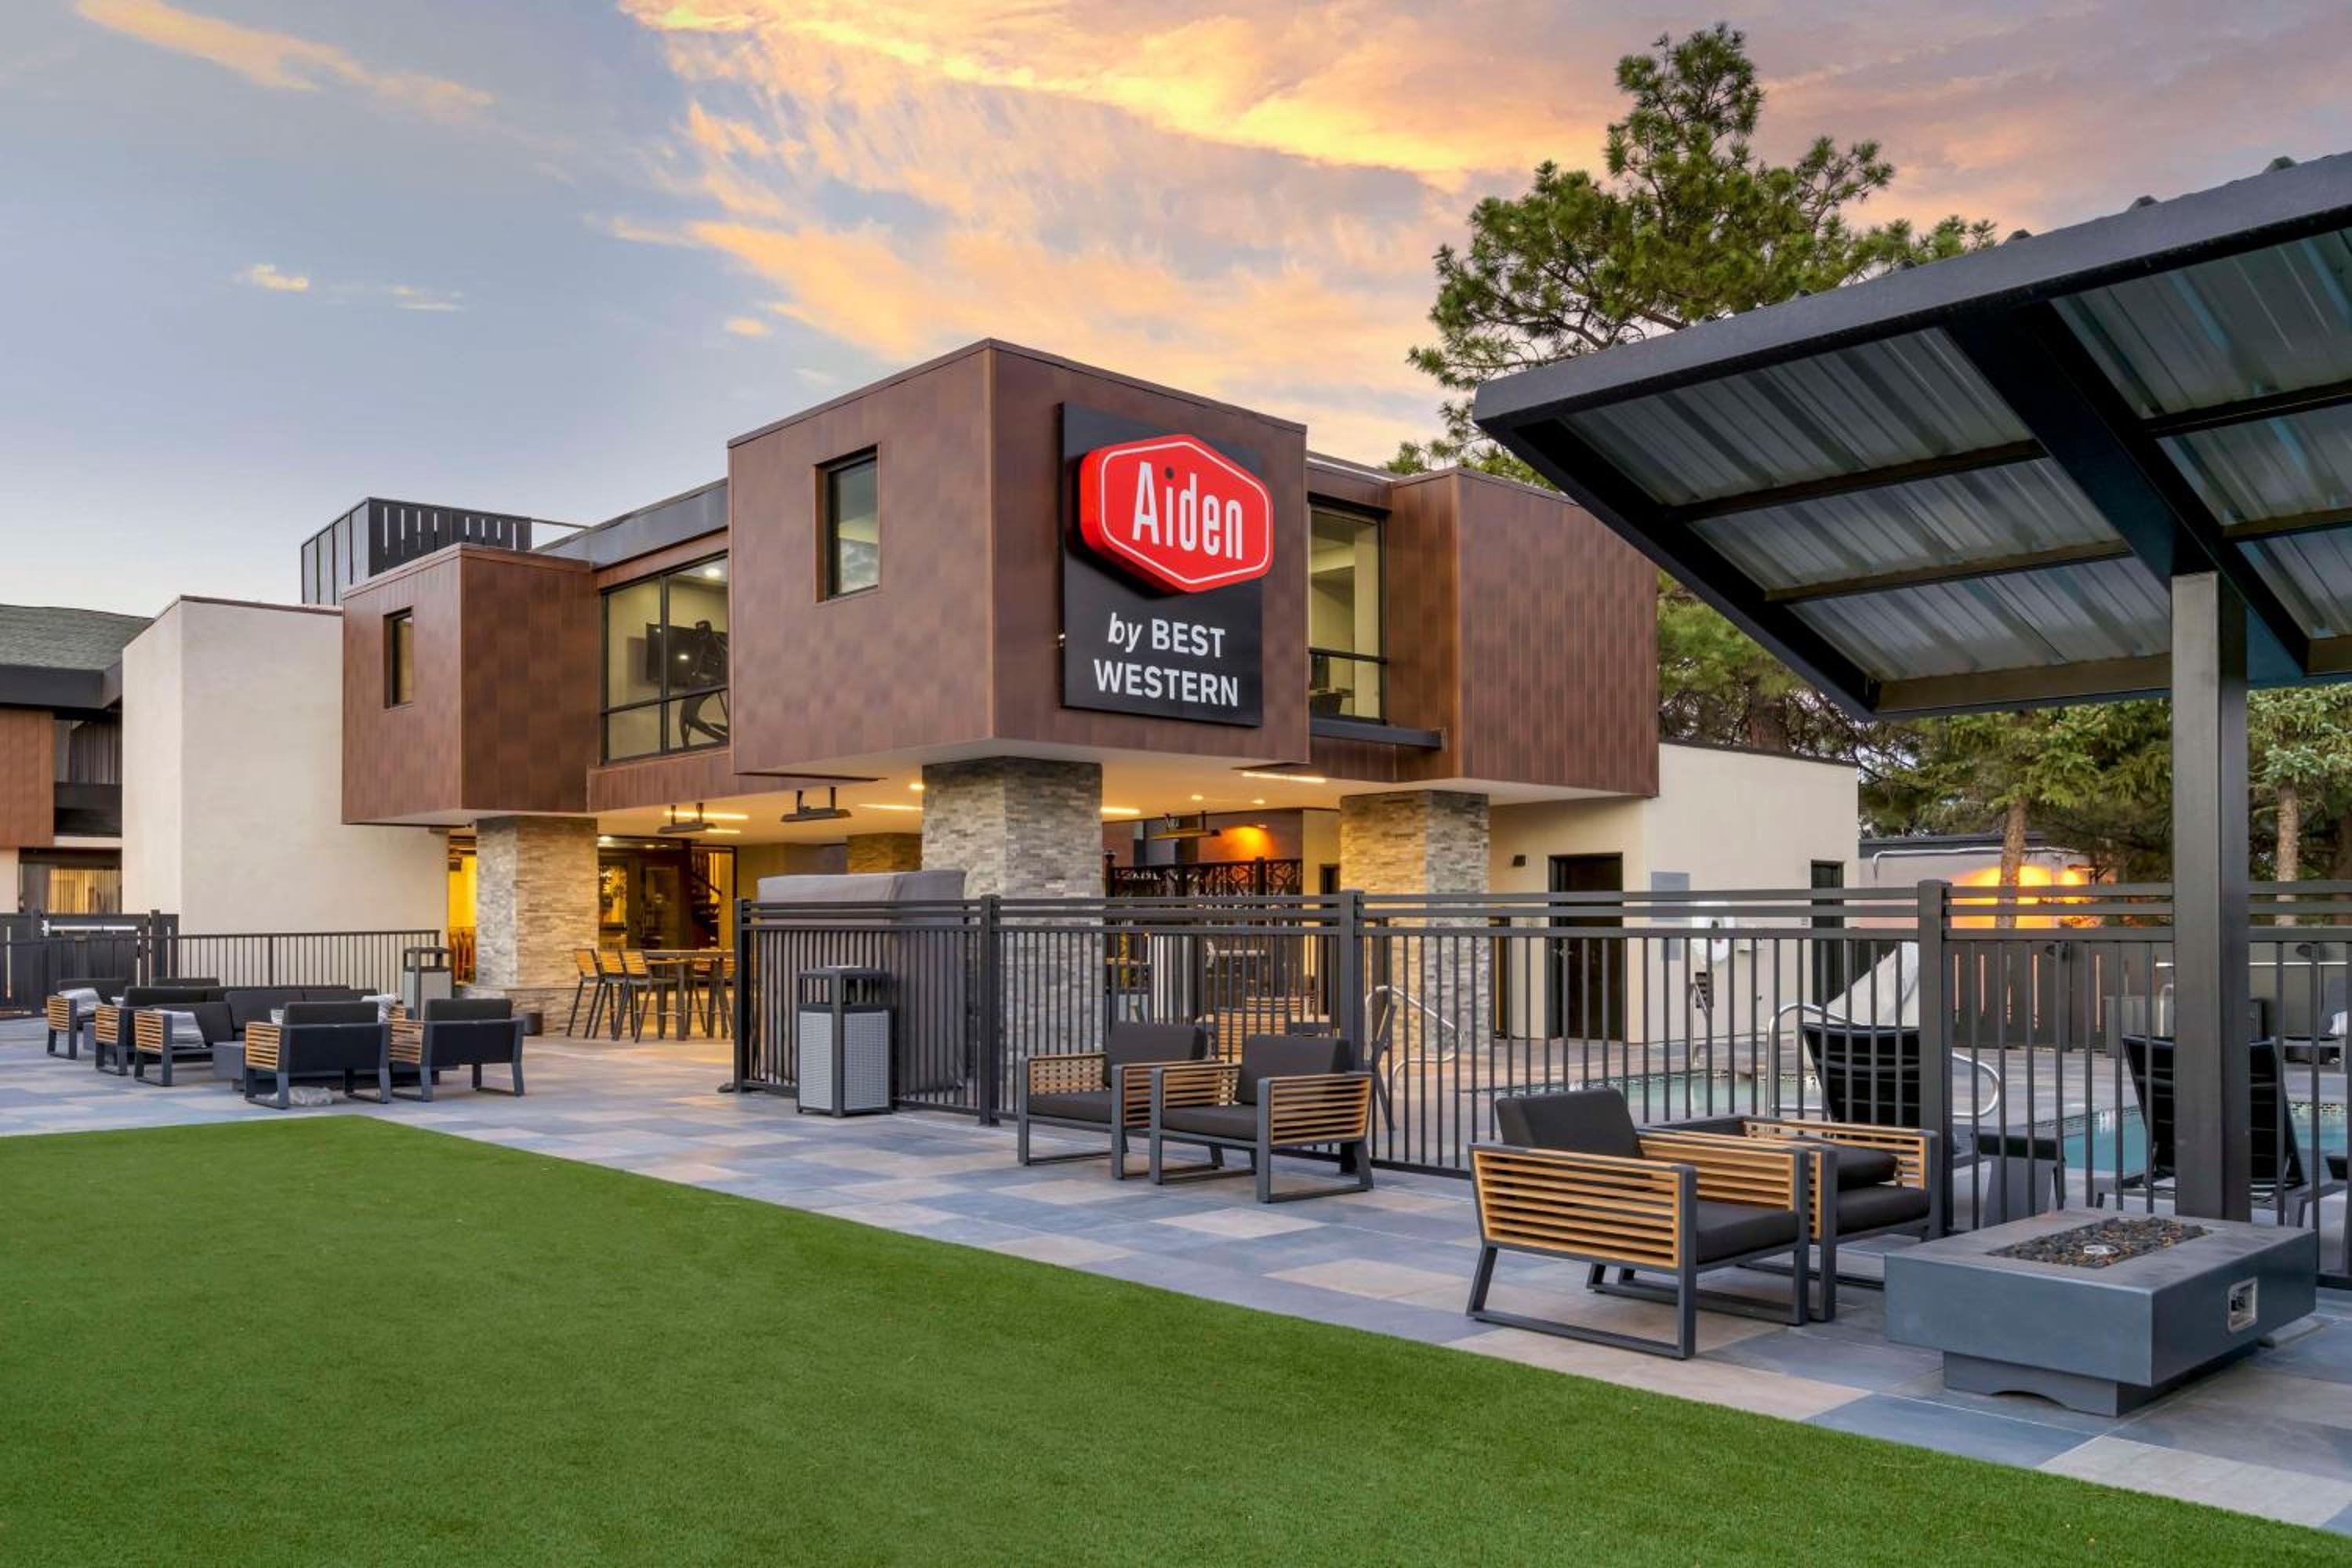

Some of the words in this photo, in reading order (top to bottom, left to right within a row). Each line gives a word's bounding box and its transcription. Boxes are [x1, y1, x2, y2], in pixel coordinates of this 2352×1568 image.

[1132, 461, 1243, 561] Aiden
[1108, 612, 1142, 653] by
[1152, 619, 1226, 659] BEST
[1093, 659, 1239, 707] WESTERN
